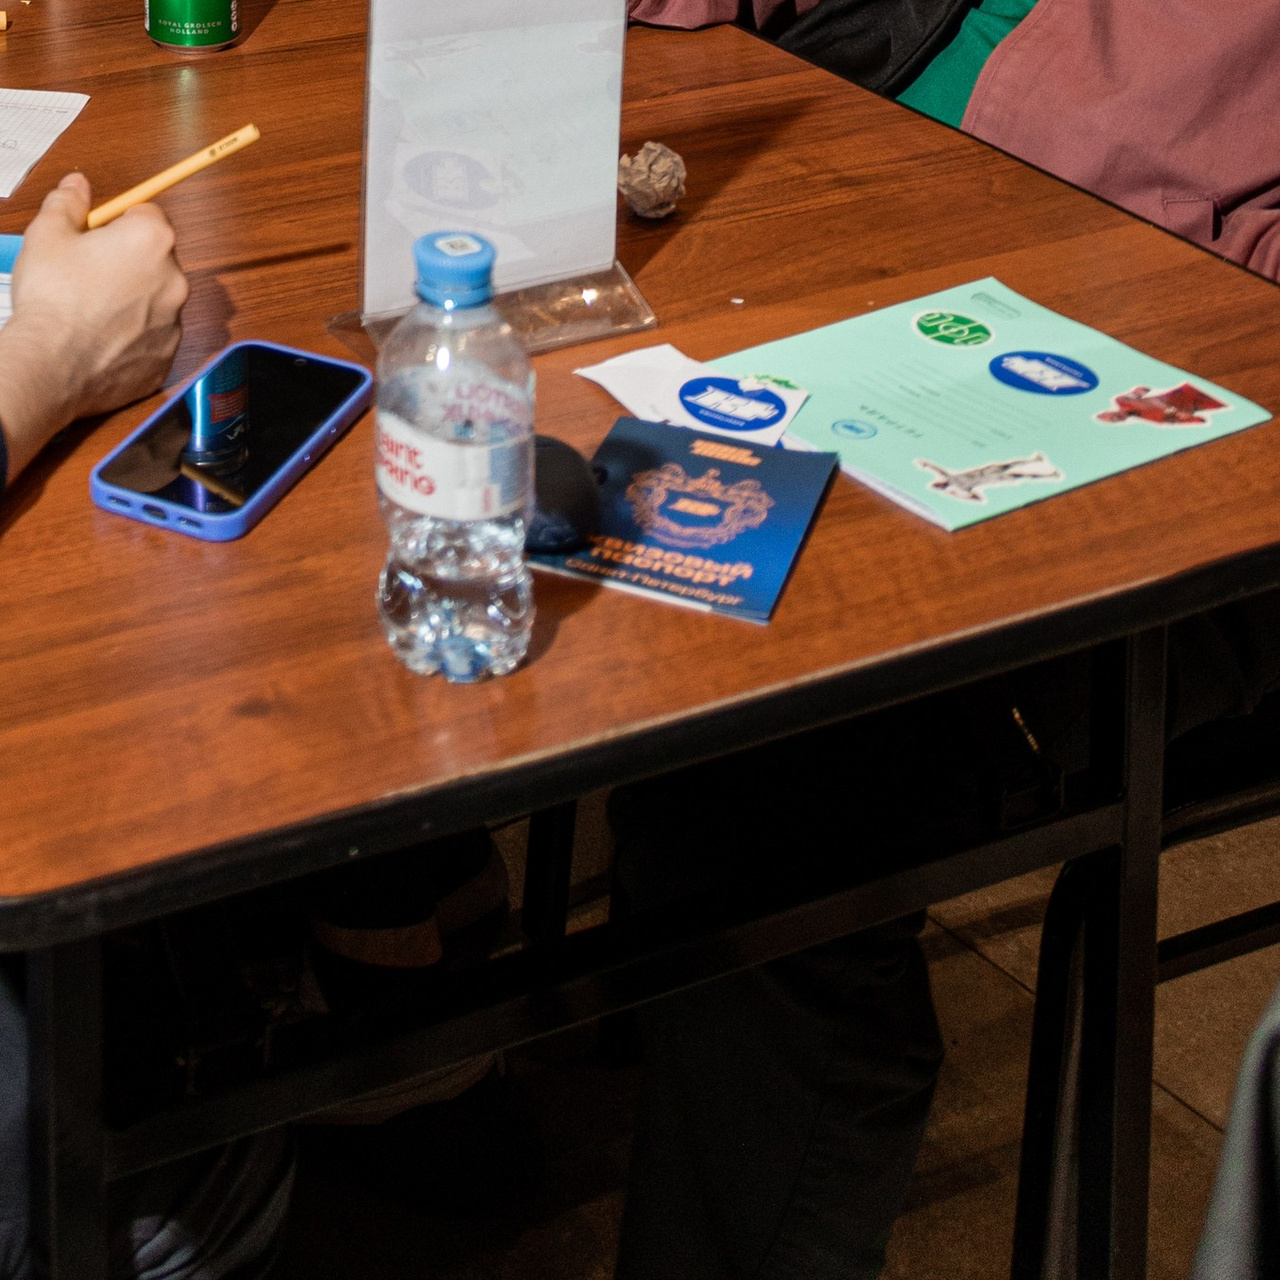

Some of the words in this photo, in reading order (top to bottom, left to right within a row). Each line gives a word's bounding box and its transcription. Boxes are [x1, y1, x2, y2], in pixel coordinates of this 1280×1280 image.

[158, 19, 181, 28] ROYAL
[184, 20, 222, 29] GROLSCH
[170, 27, 209, 36] HOLLAND
